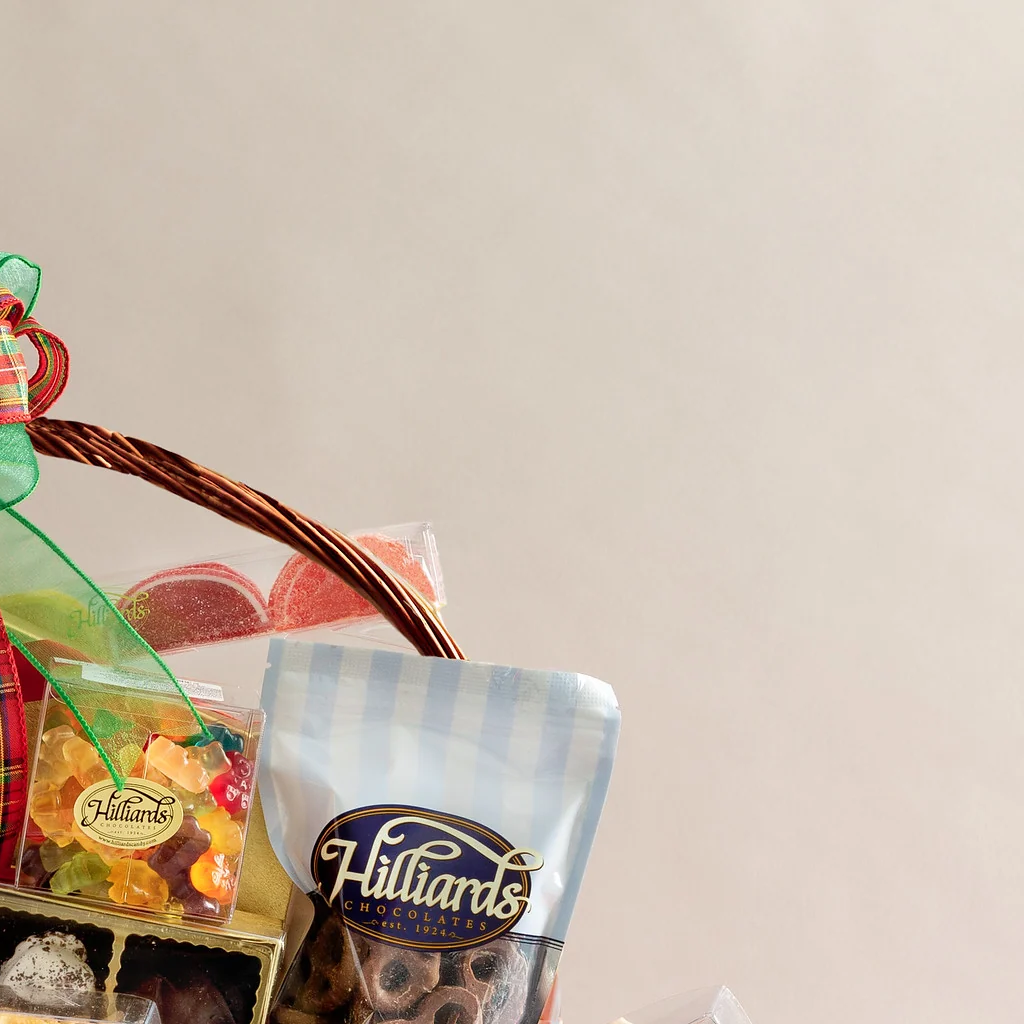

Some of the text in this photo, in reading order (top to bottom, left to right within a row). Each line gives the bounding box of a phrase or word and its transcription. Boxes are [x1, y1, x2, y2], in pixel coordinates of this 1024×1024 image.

[67, 591, 150, 638] Hillds
[81, 788, 176, 827] Hilliards
[100, 822, 156, 830] CHOCOLATES
[318, 816, 544, 919] Hilliards
[344, 900, 488, 932] CHOCOLATES
[382, 919, 446, 937] est. 1924
